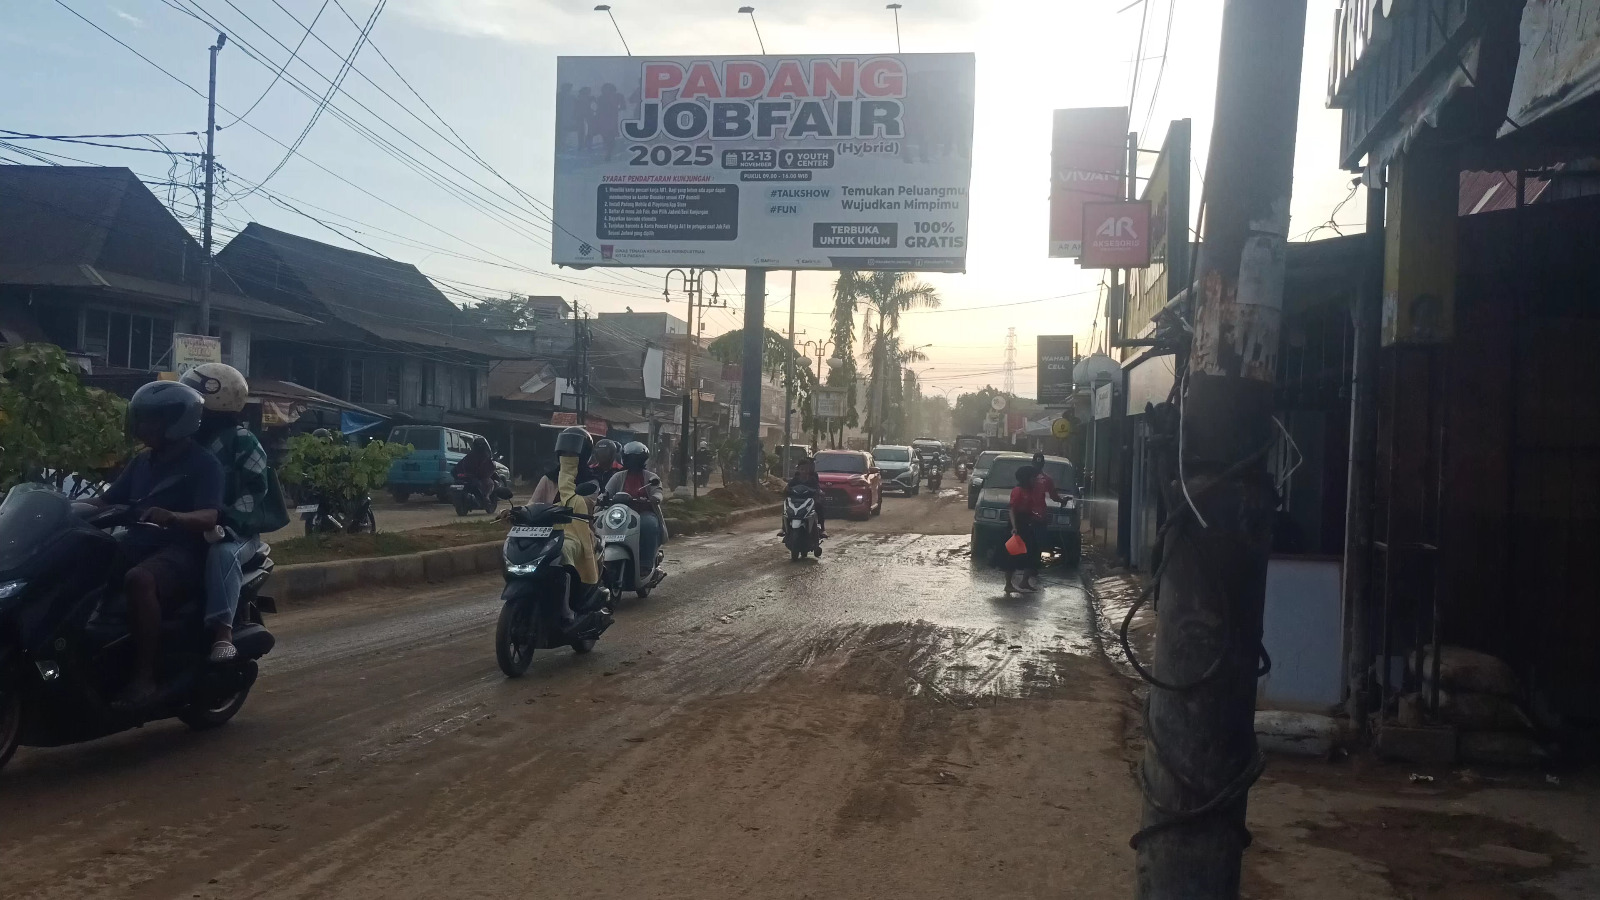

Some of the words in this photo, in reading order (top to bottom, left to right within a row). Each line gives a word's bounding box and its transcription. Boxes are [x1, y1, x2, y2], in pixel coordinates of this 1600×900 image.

[644, 62, 904, 99] PADANG
[623, 101, 903, 139] JOBFAIR
[836, 142, 899, 157] (Hybrid)
[628, 145, 714, 167] 2025
[741, 152, 772, 161] 12-13
[1059, 170, 1120, 182] VIVAN
[770, 189, 830, 198] #TALKSHOW
[841, 186, 895, 196] Temukan
[770, 205, 797, 214] #FUN
[841, 200, 901, 212] Wujudkan
[903, 200, 960, 212] Mimpimu
[830, 226, 880, 234] TERBUKA
[913, 222, 955, 234] 100%
[1096, 216, 1138, 240] AR
[819, 236, 855, 245] UNTUK
[857, 236, 890, 245] UMUM
[904, 236, 965, 248] GRATIS
